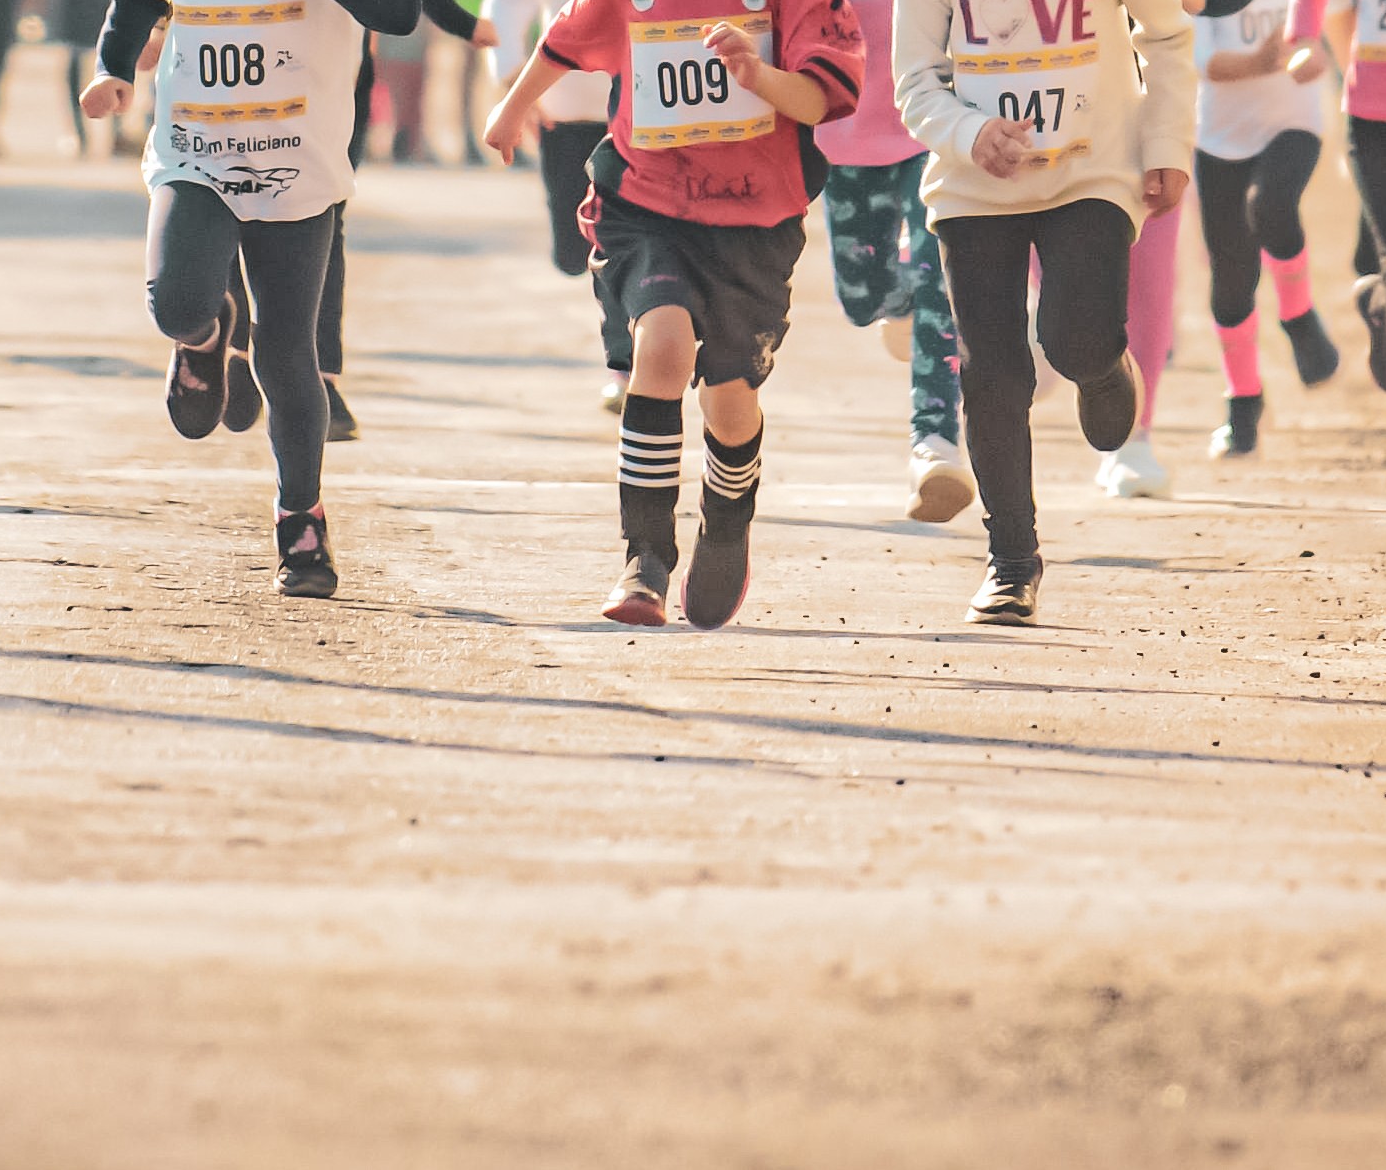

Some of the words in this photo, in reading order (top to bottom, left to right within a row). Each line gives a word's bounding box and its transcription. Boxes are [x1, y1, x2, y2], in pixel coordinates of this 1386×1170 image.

[199, 43, 265, 87] 008
[657, 58, 729, 108] 009
[998, 88, 1065, 133] 047
[227, 135, 301, 153] Feliciano
